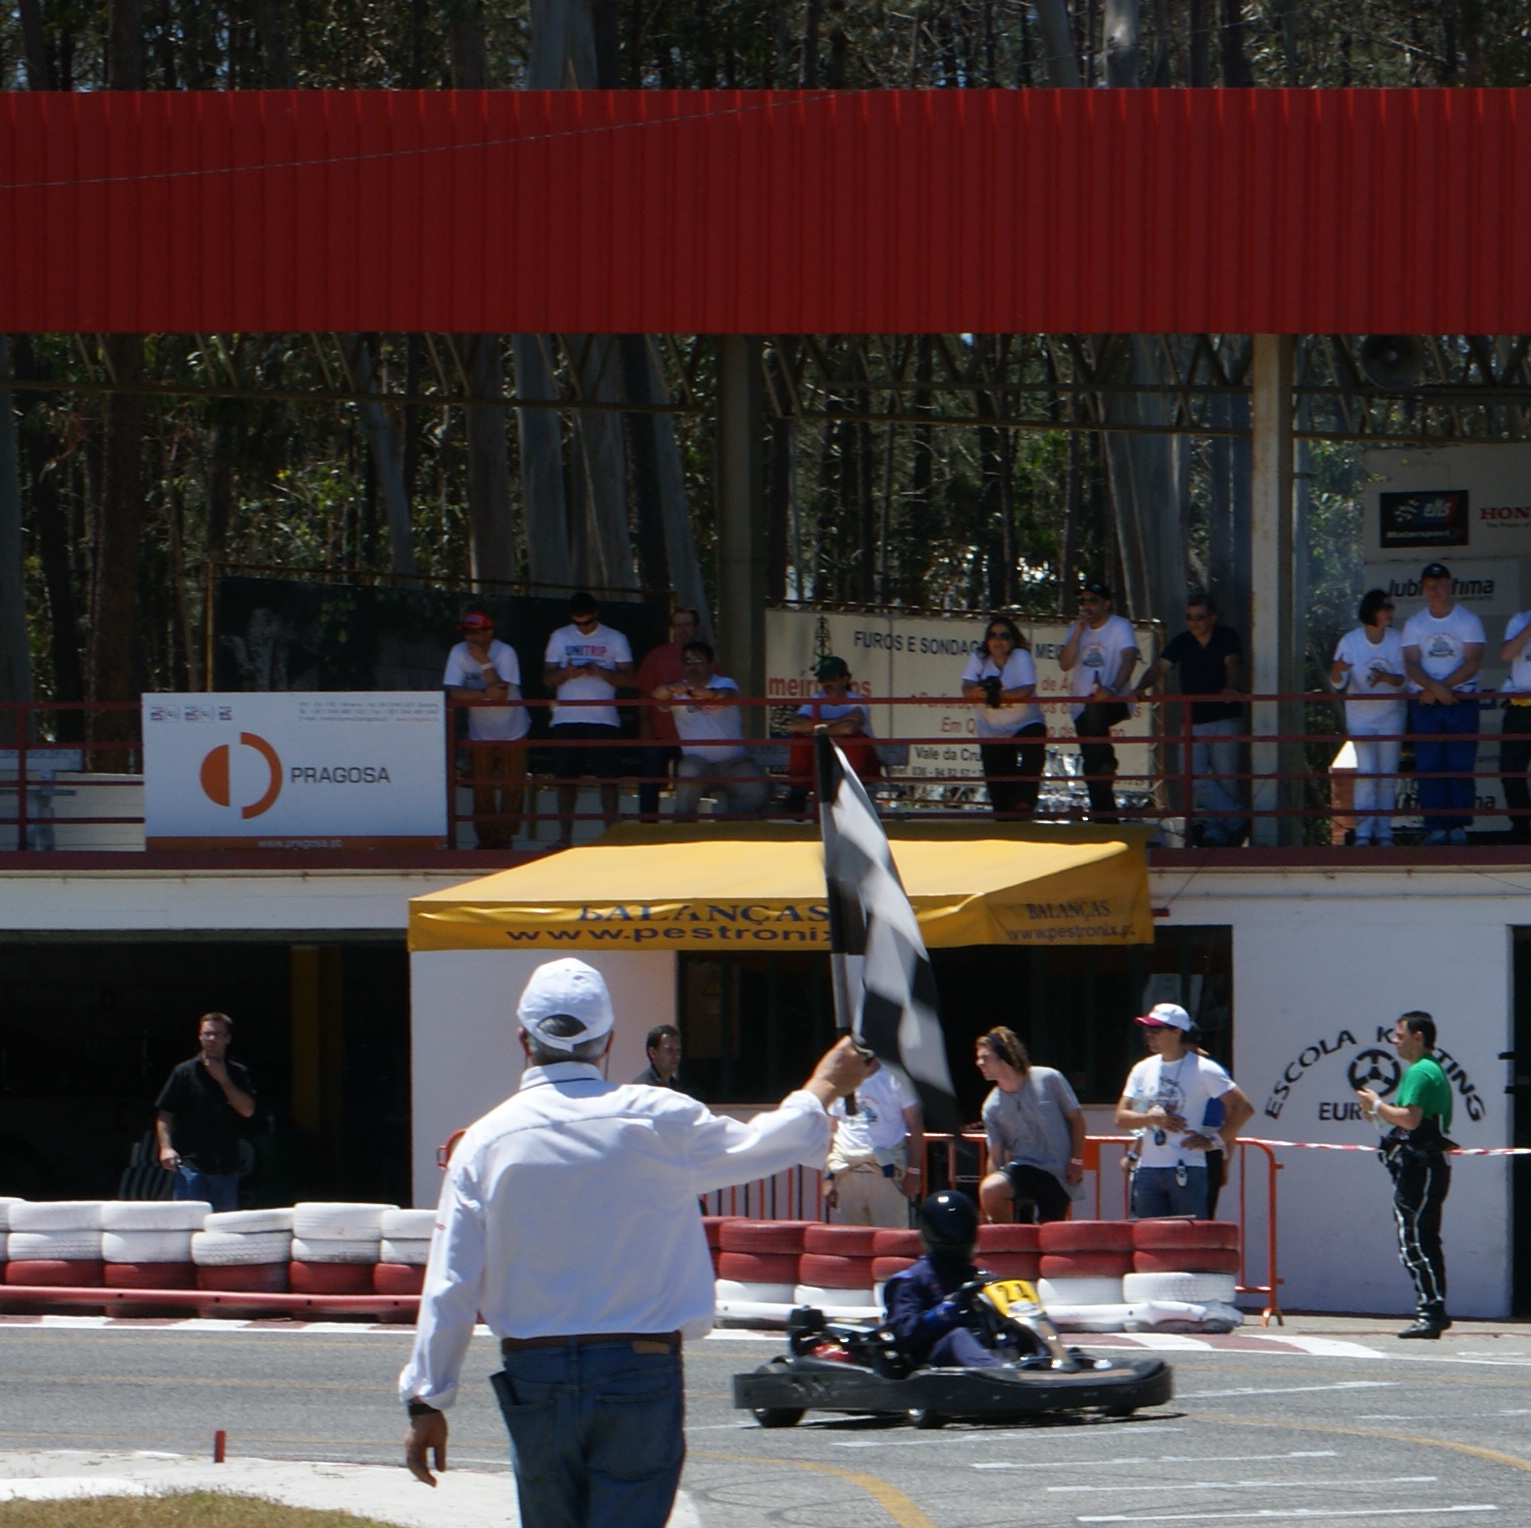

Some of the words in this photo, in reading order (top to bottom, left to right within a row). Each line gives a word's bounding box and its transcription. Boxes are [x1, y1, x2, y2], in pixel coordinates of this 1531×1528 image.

[852, 630, 902, 652] FUROS
[906, 635, 916, 653] E
[290, 766, 391, 784] PRAGOSA
[1025, 900, 1111, 922] BALANÇAS
[1265, 1029, 1358, 1120] ESCOLA
[1377, 1026, 1487, 1122] KTING
